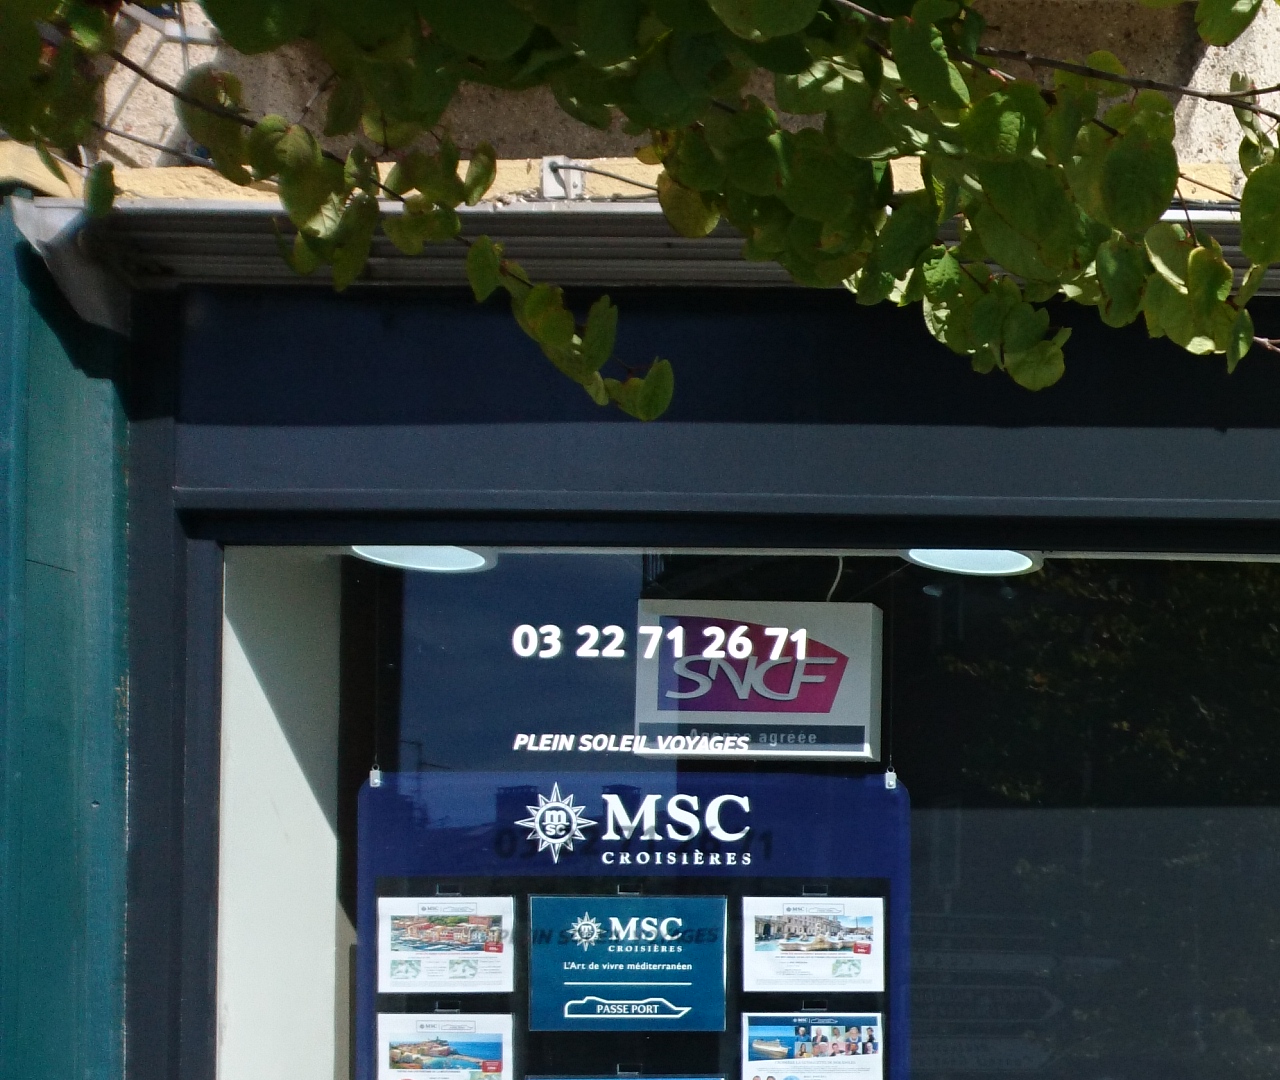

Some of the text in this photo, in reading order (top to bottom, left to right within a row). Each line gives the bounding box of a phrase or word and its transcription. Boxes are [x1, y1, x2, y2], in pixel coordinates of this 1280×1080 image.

[512, 624, 808, 661] 03 22 71 26 71
[665, 656, 838, 701] SNCF
[513, 733, 750, 753] PLEIN SOLEIL VOYAGES
[601, 793, 751, 842] MSC
[601, 847, 752, 866] CROISIÈRES
[608, 916, 683, 941] MSC
[608, 943, 683, 953] CROISIÈRES
[563, 961, 693, 970] L'Art de vivre méditerranéen
[596, 1004, 660, 1014] PASSE PORT
